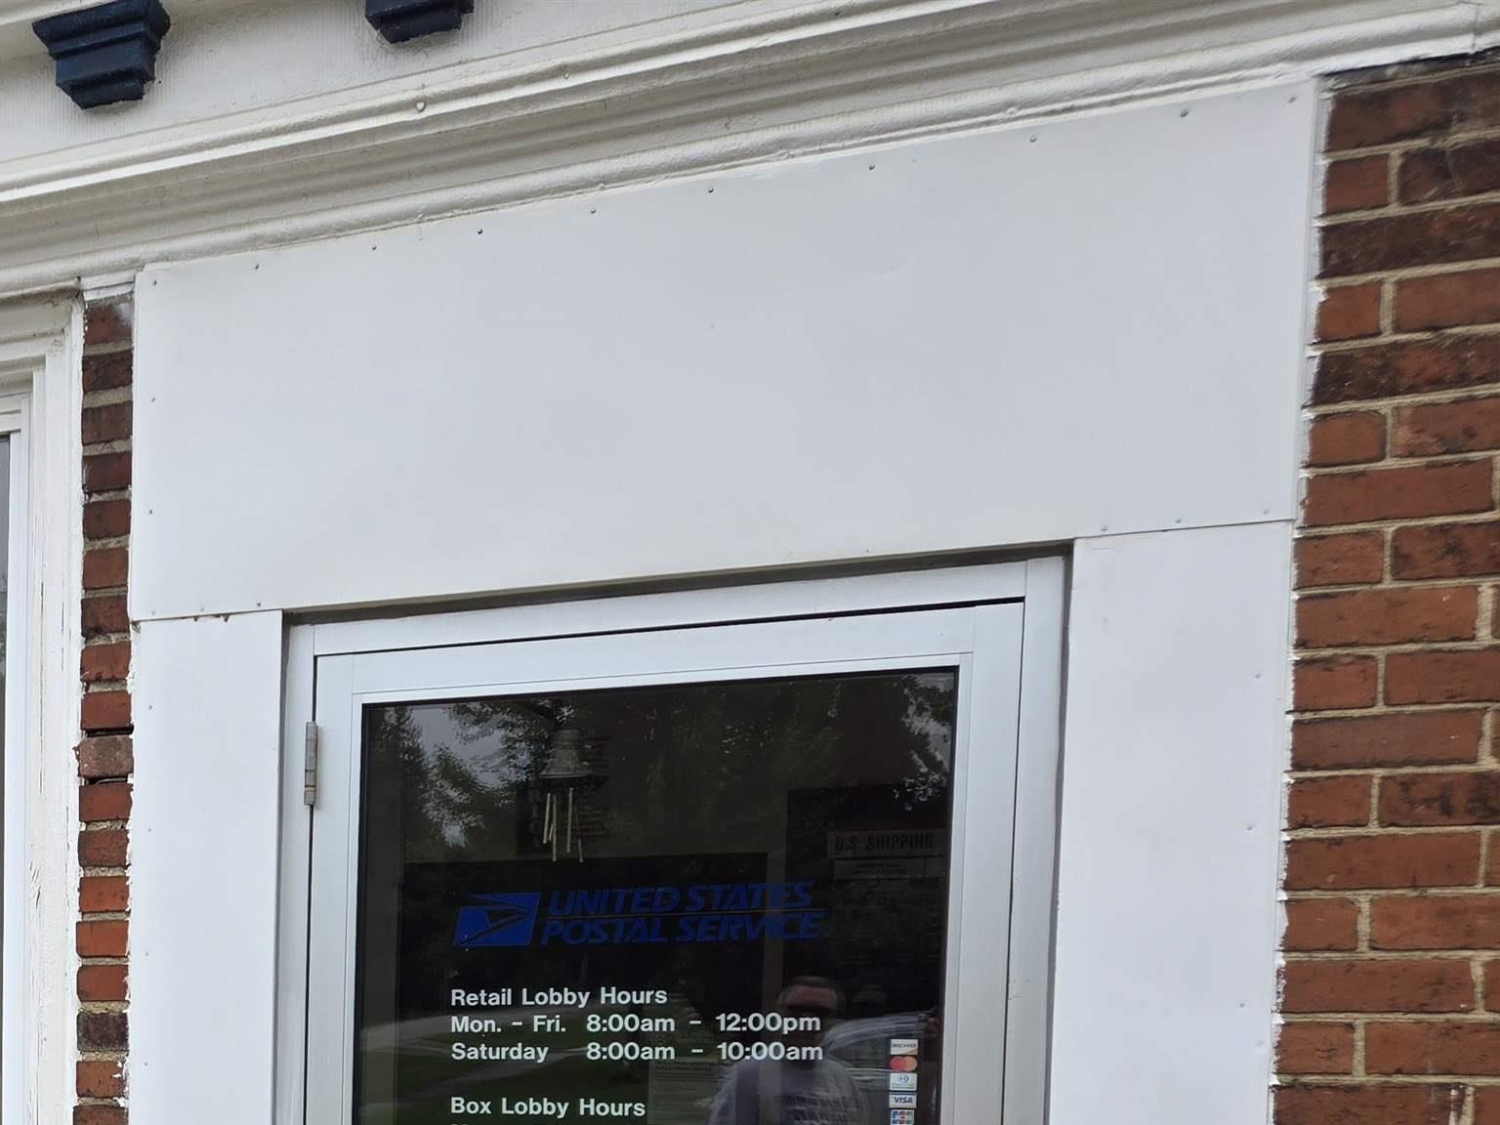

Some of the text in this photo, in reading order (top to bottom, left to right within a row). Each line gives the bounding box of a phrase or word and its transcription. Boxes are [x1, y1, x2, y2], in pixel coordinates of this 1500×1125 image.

[867, 833, 934, 850] SHIPPING
[551, 881, 814, 916] UNITED STATES
[541, 911, 827, 945] POSTAL SERVICE
[451, 987, 668, 1009] Retail Lobby Hours
[451, 1015, 502, 1033] Mon.
[533, 1014, 566, 1033] Fri.
[586, 1014, 675, 1032] 8:00am
[716, 1013, 821, 1034] 12:00pm
[451, 1042, 549, 1063] Saturday
[586, 1042, 675, 1060] 8:00am
[717, 1041, 823, 1060] 10:00am
[451, 1097, 646, 1118] Box Lobby Hours
